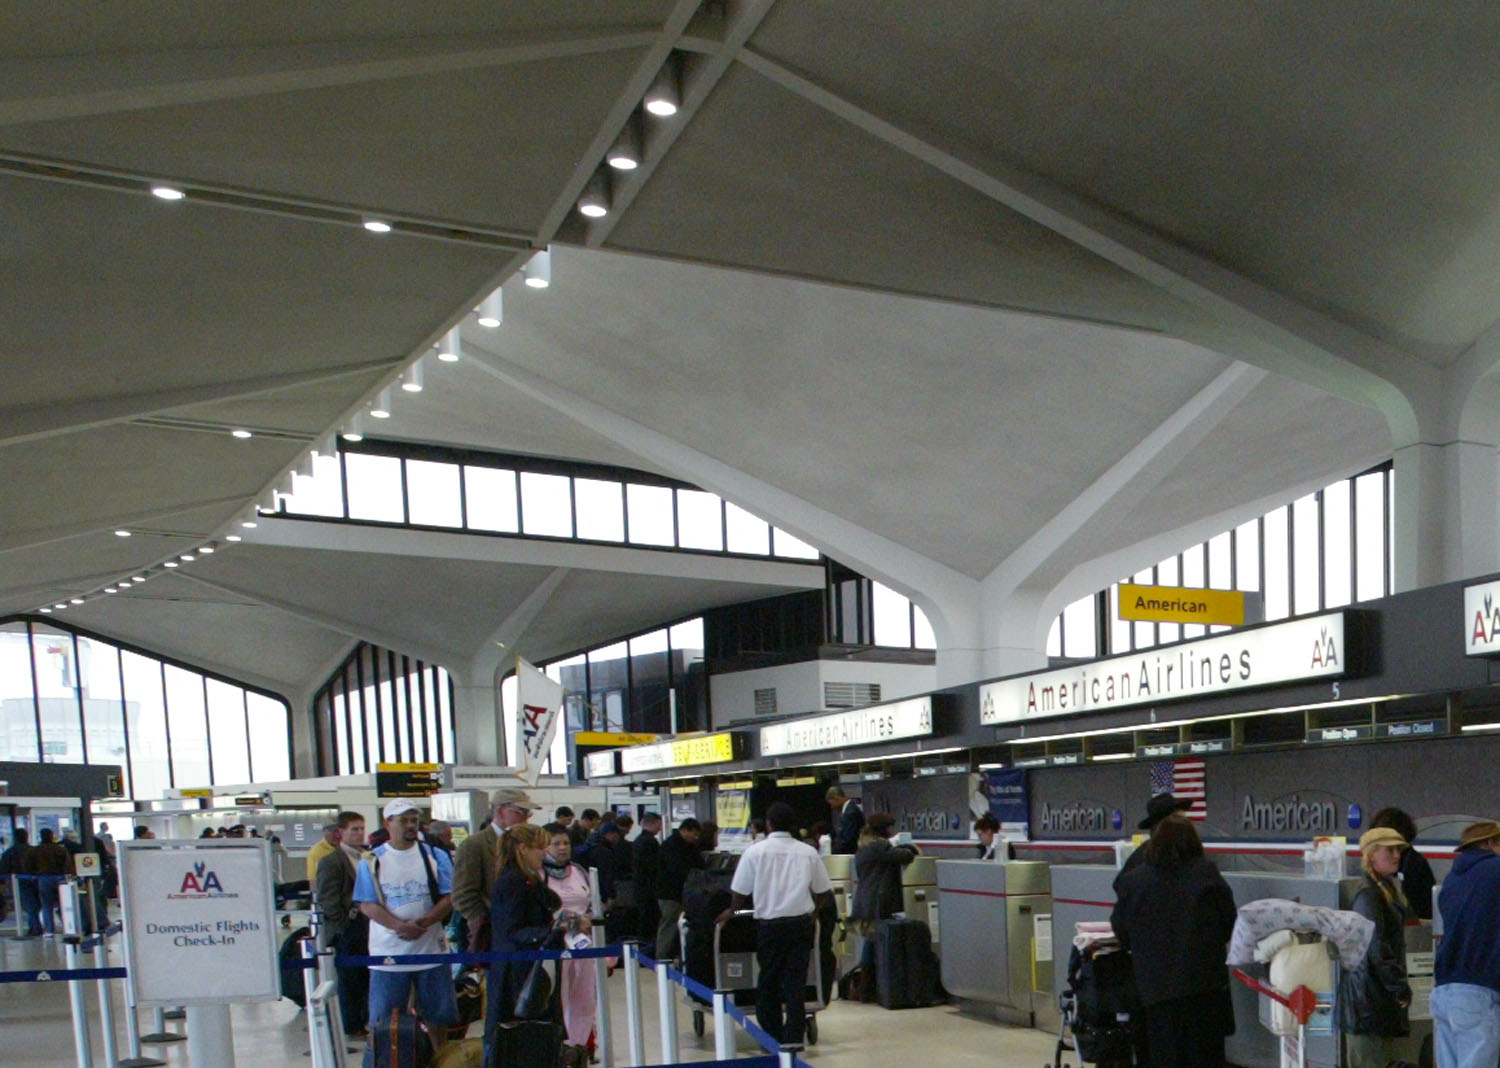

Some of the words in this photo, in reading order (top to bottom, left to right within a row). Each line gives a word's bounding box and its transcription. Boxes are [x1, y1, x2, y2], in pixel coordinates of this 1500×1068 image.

[1134, 595, 1207, 614] American
[1332, 682, 1340, 699] 5
[1041, 802, 1105, 831] American
[1242, 794, 1337, 831] American
[181, 871, 223, 892] AA
[146, 921, 211, 935] Domestic
[216, 920, 260, 934] Flights
[173, 935, 235, 947] Check-In
